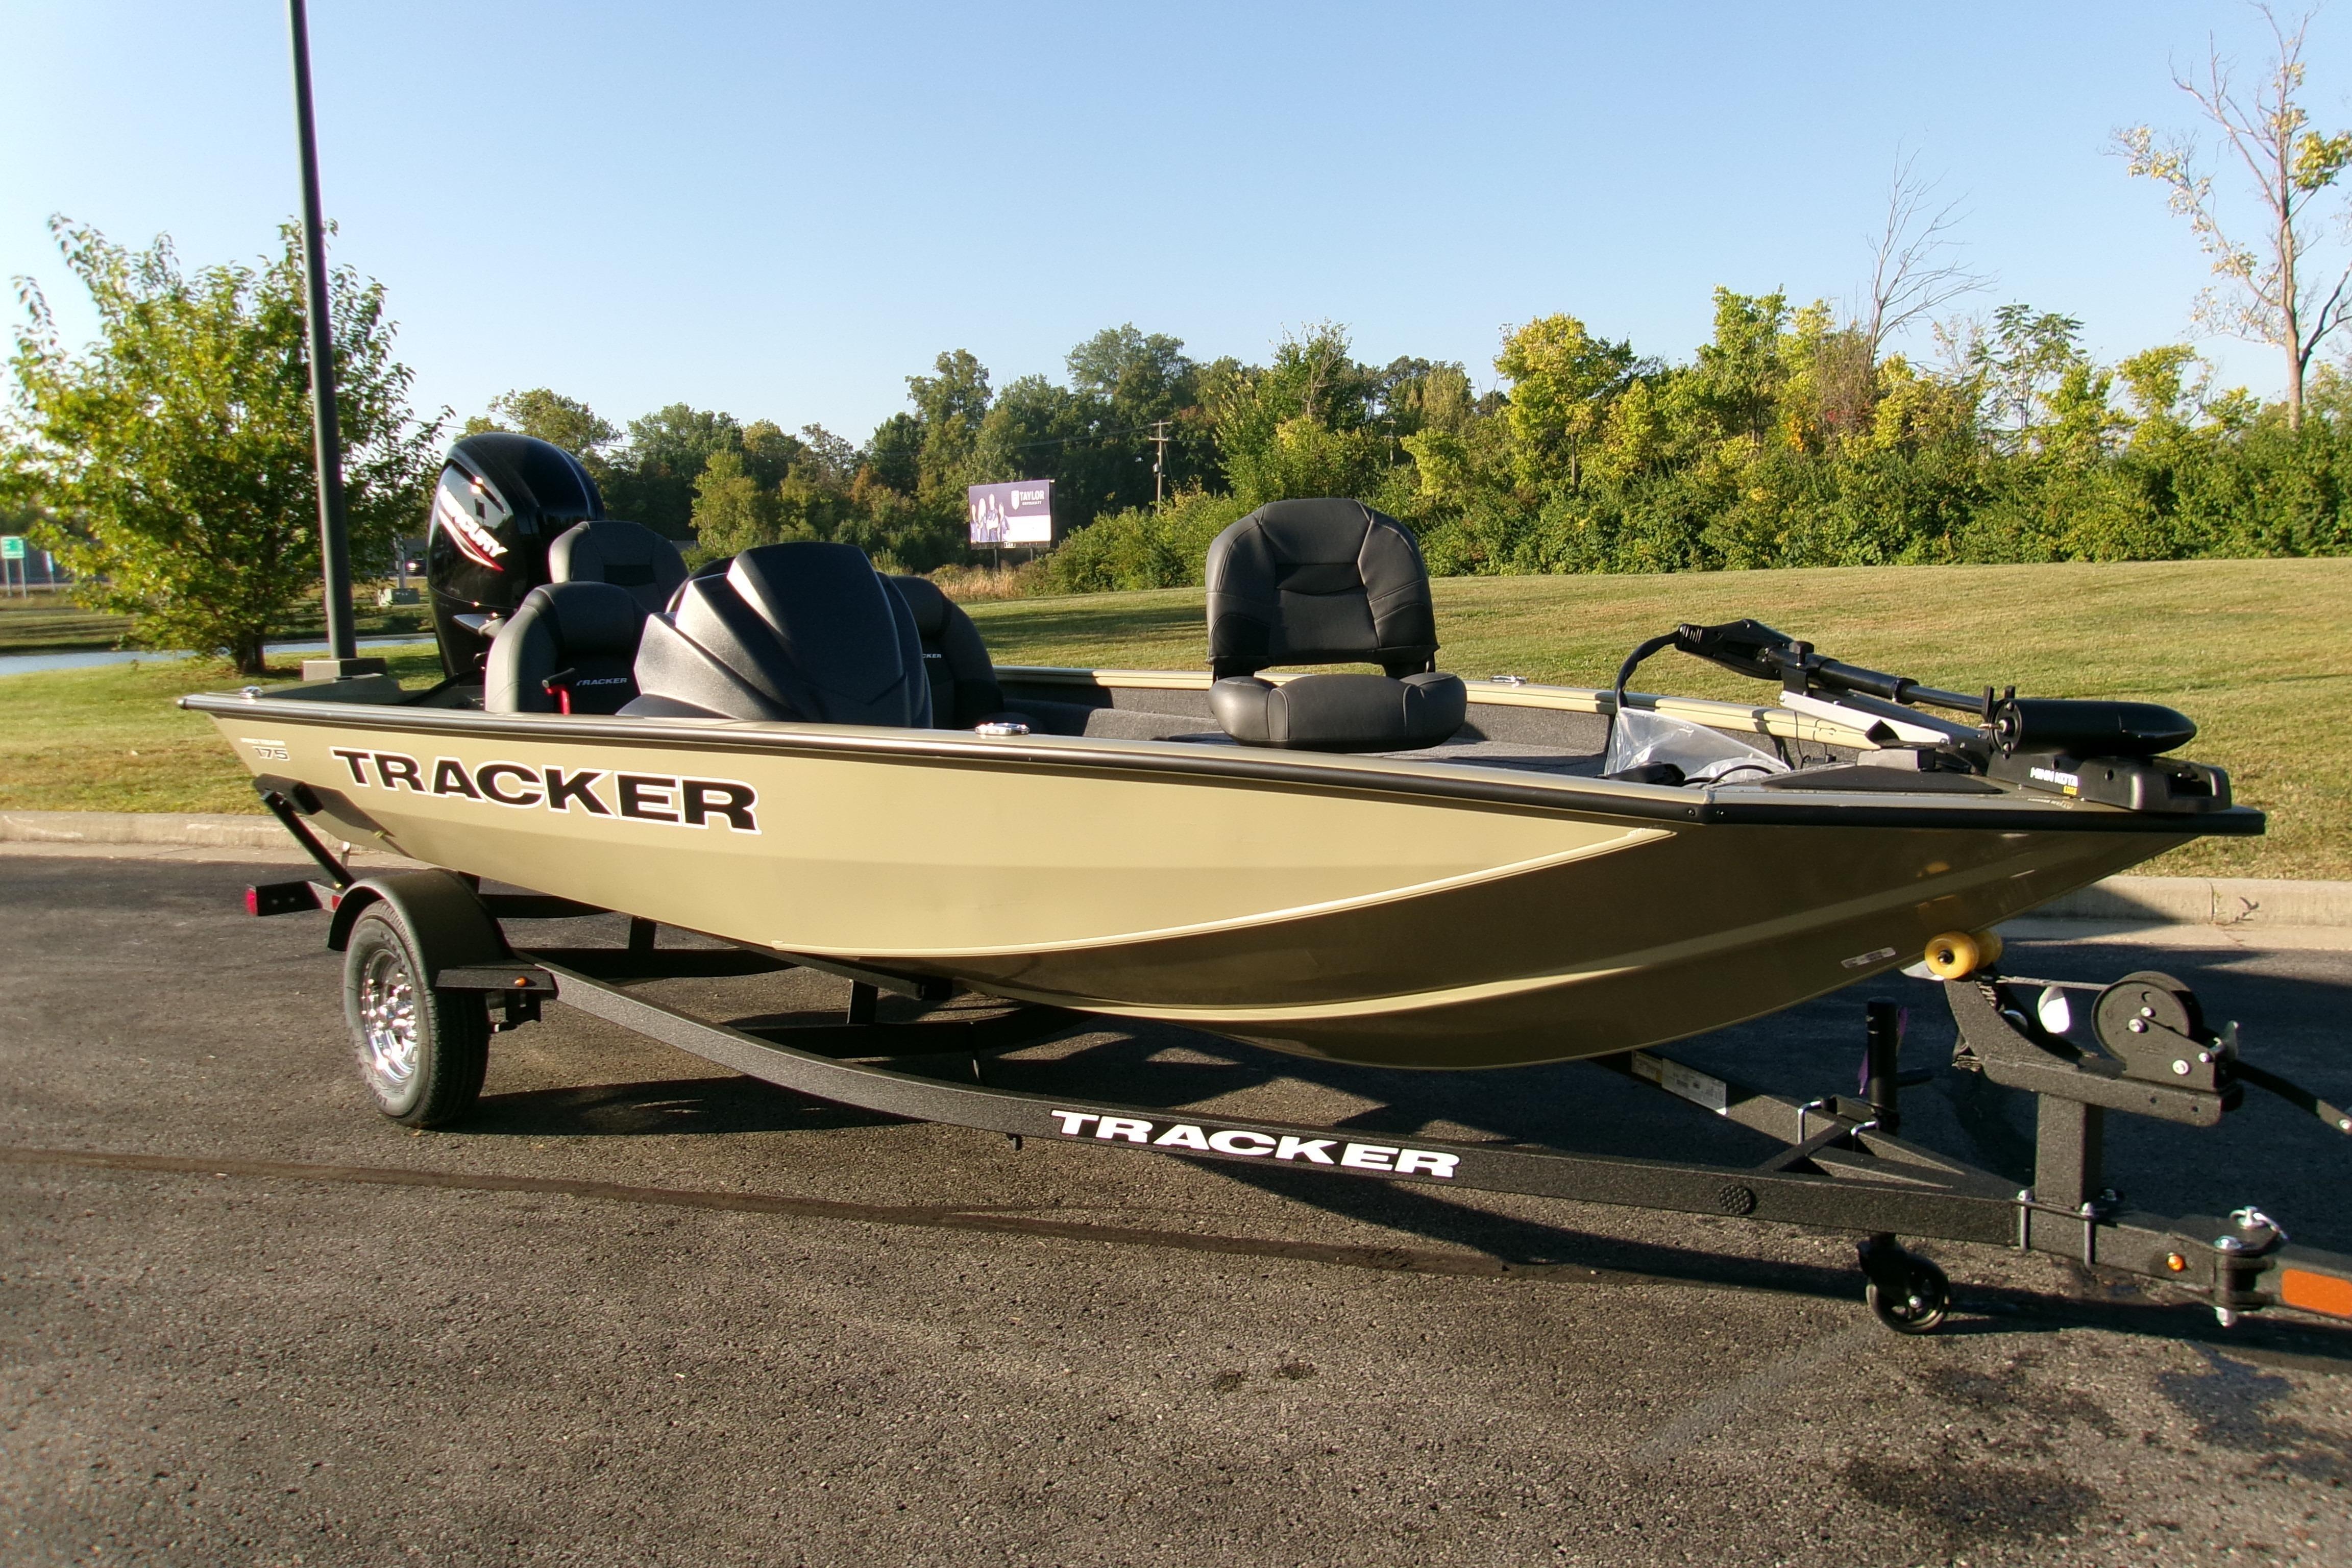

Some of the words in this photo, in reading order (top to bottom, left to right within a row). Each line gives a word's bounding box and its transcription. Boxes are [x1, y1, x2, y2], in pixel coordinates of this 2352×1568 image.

[439, 484, 509, 557] RCURY
[1020, 490, 1044, 501] TAYLOR
[253, 746, 290, 761] 175
[329, 747, 762, 835] TRACKER
[1050, 1110, 1461, 1179] TRACKER
